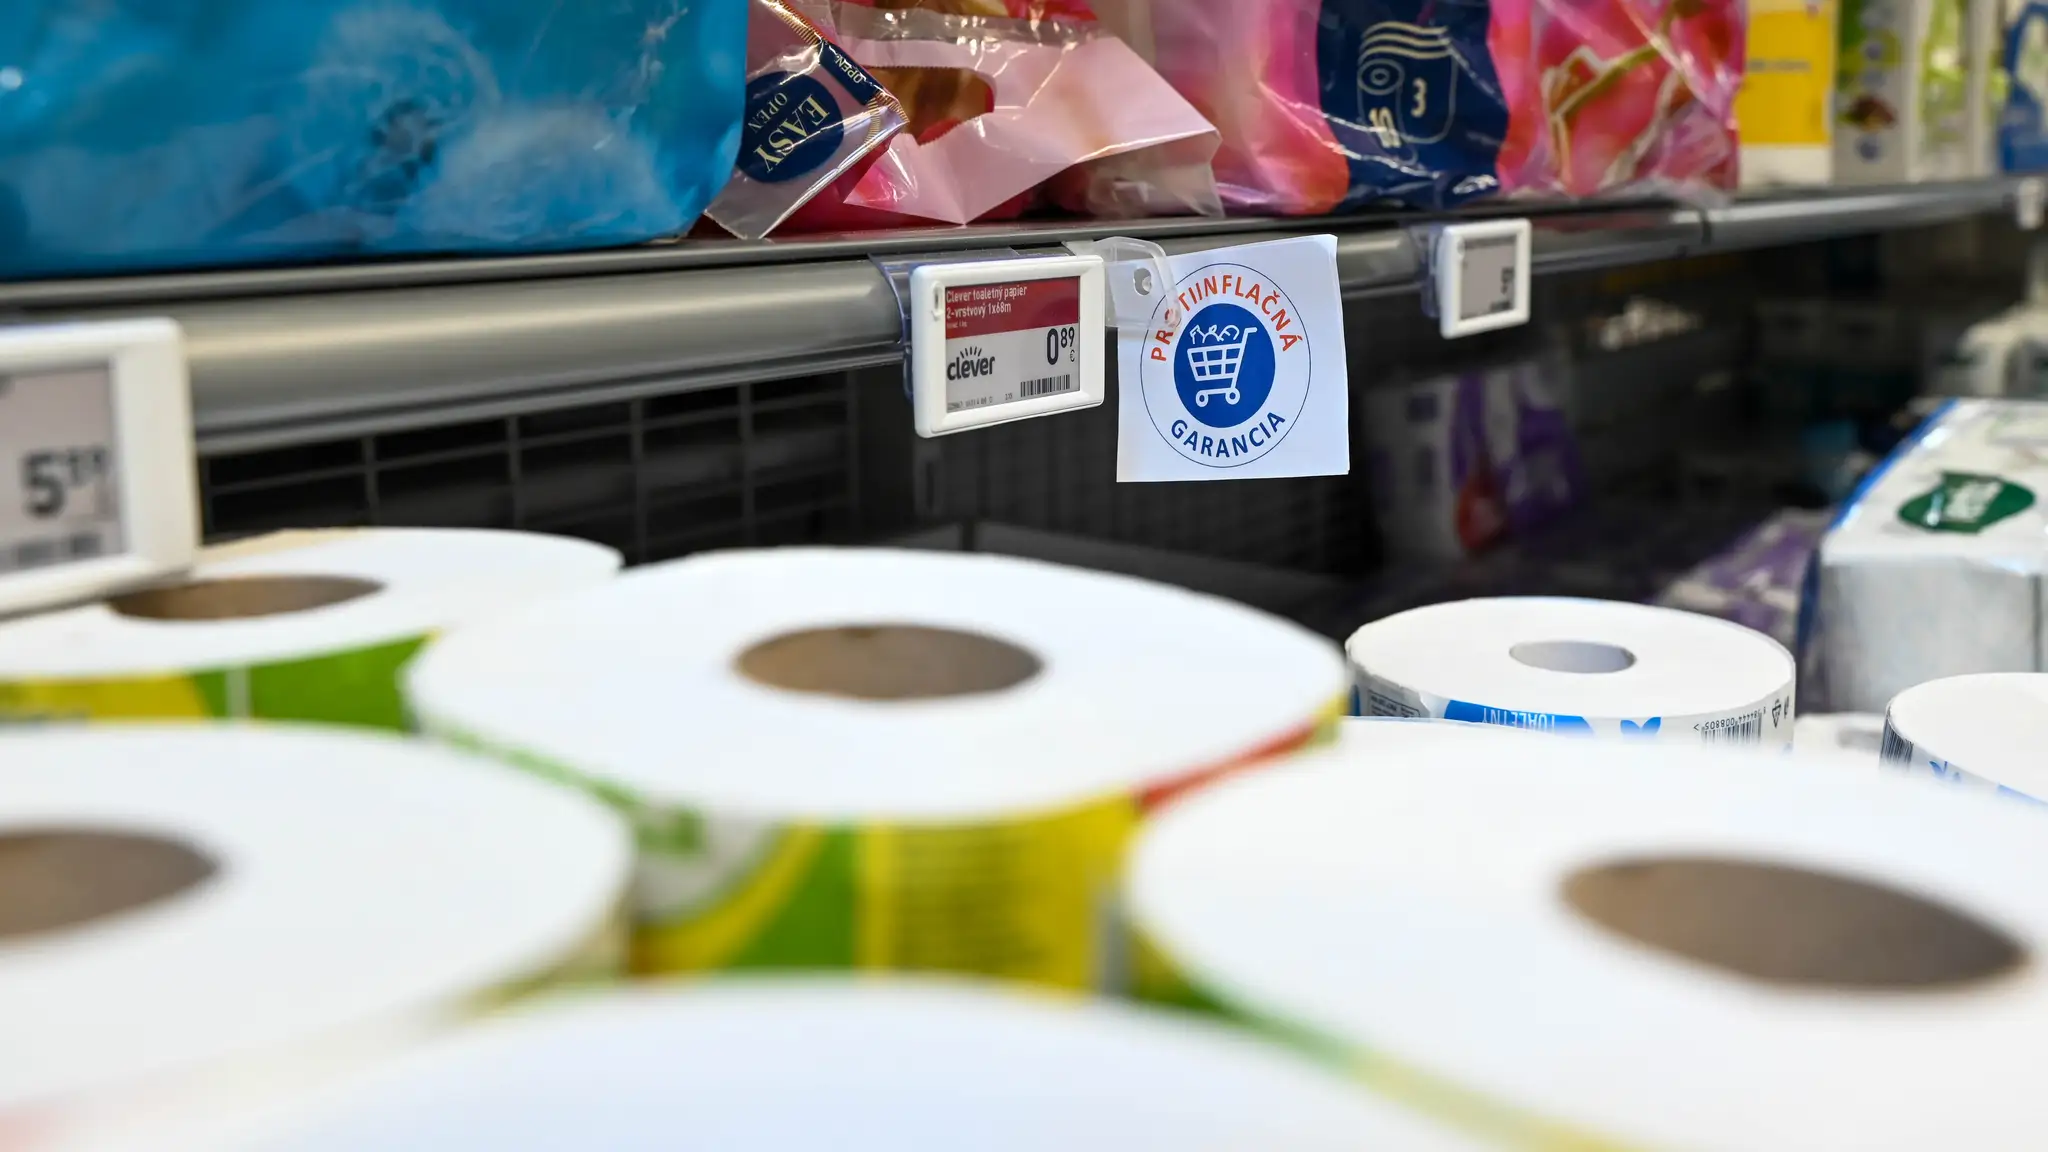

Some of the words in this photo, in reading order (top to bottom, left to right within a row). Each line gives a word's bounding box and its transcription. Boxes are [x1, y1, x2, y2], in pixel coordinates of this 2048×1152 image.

[834, 56, 864, 84] OPEN
[748, 92, 788, 134] OPEN
[1411, 78, 1427, 118] 3
[753, 94, 830, 172] EASY
[946, 289, 972, 303] Clever
[973, 285, 1003, 301] toaletný
[1004, 285, 1027, 300] papier
[988, 301, 1012, 315] 1x68m
[946, 356, 995, 381] clever
[1171, 411, 1286, 458] GARANCIA
